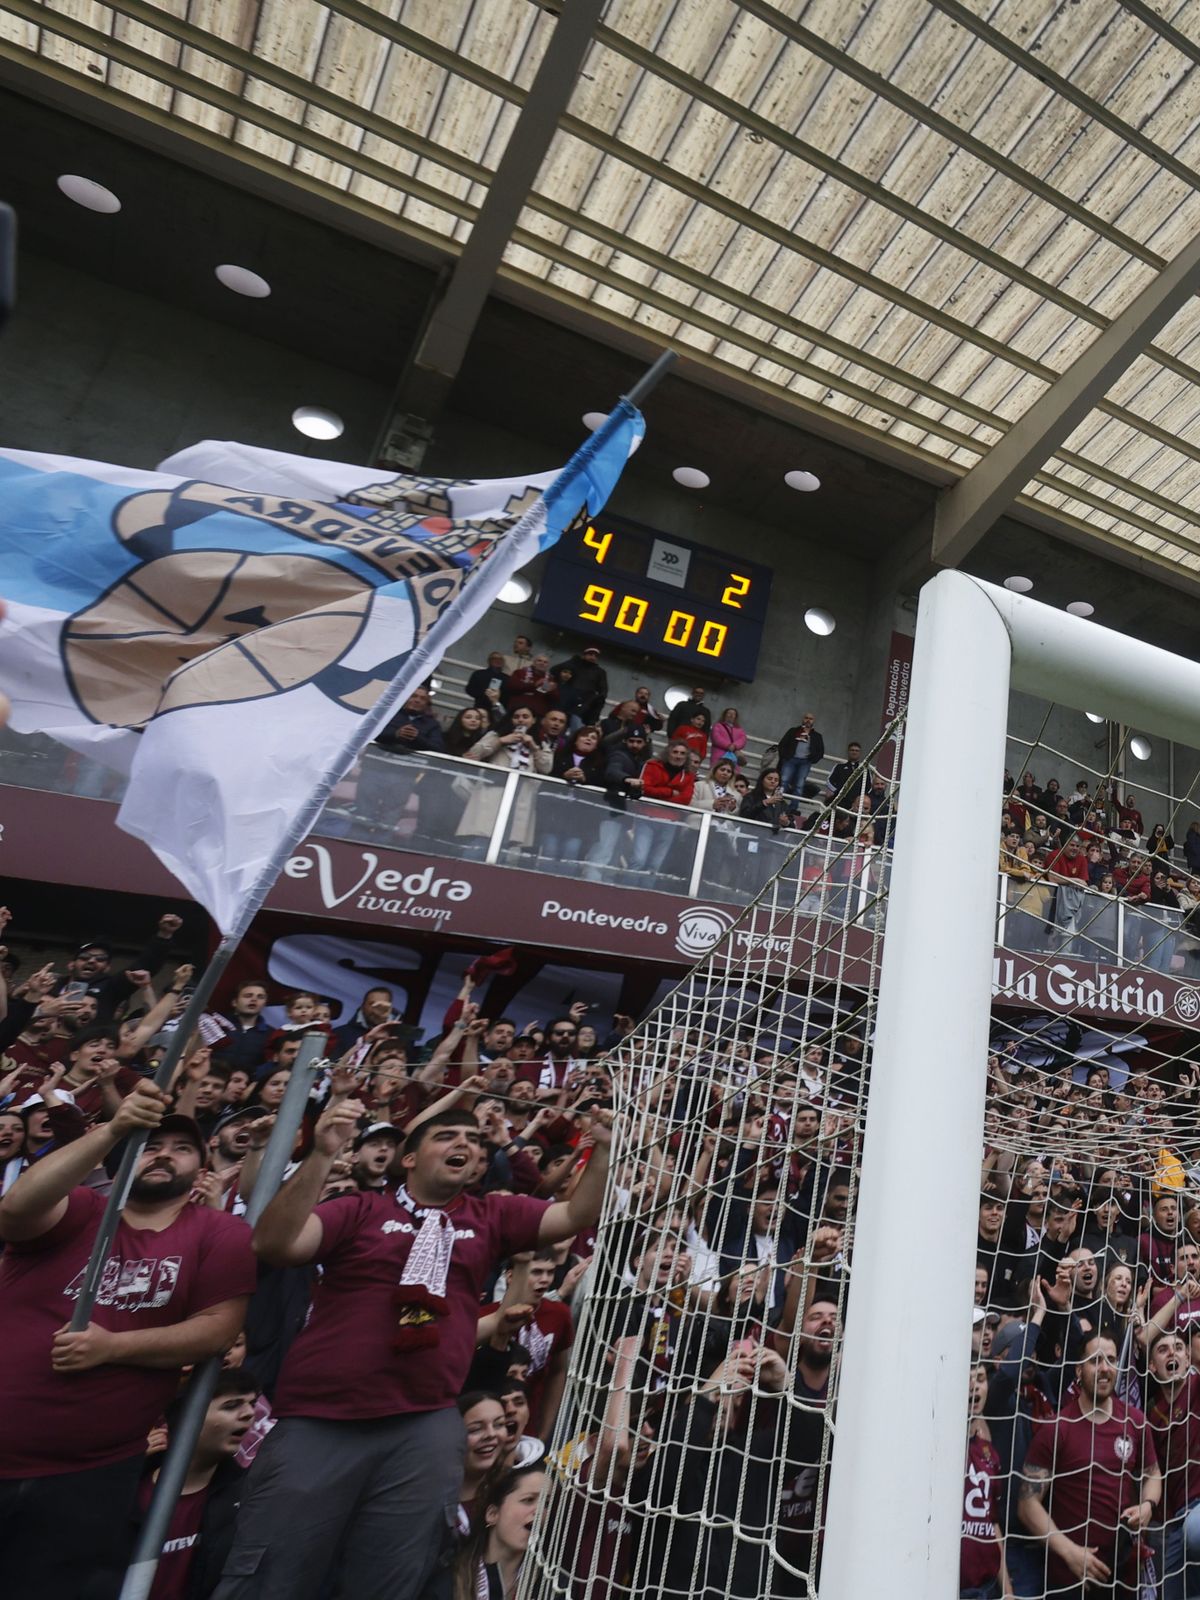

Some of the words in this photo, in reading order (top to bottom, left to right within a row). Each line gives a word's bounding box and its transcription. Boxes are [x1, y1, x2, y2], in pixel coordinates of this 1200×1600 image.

[582, 526, 613, 565] 4
[721, 573, 752, 609] 2
[578, 584, 649, 634] 90
[662, 610, 728, 657] 00
[541, 900, 668, 936] Pontevedra
[683, 922, 718, 944] Viva
[1046, 963, 1165, 1018] Galicia
